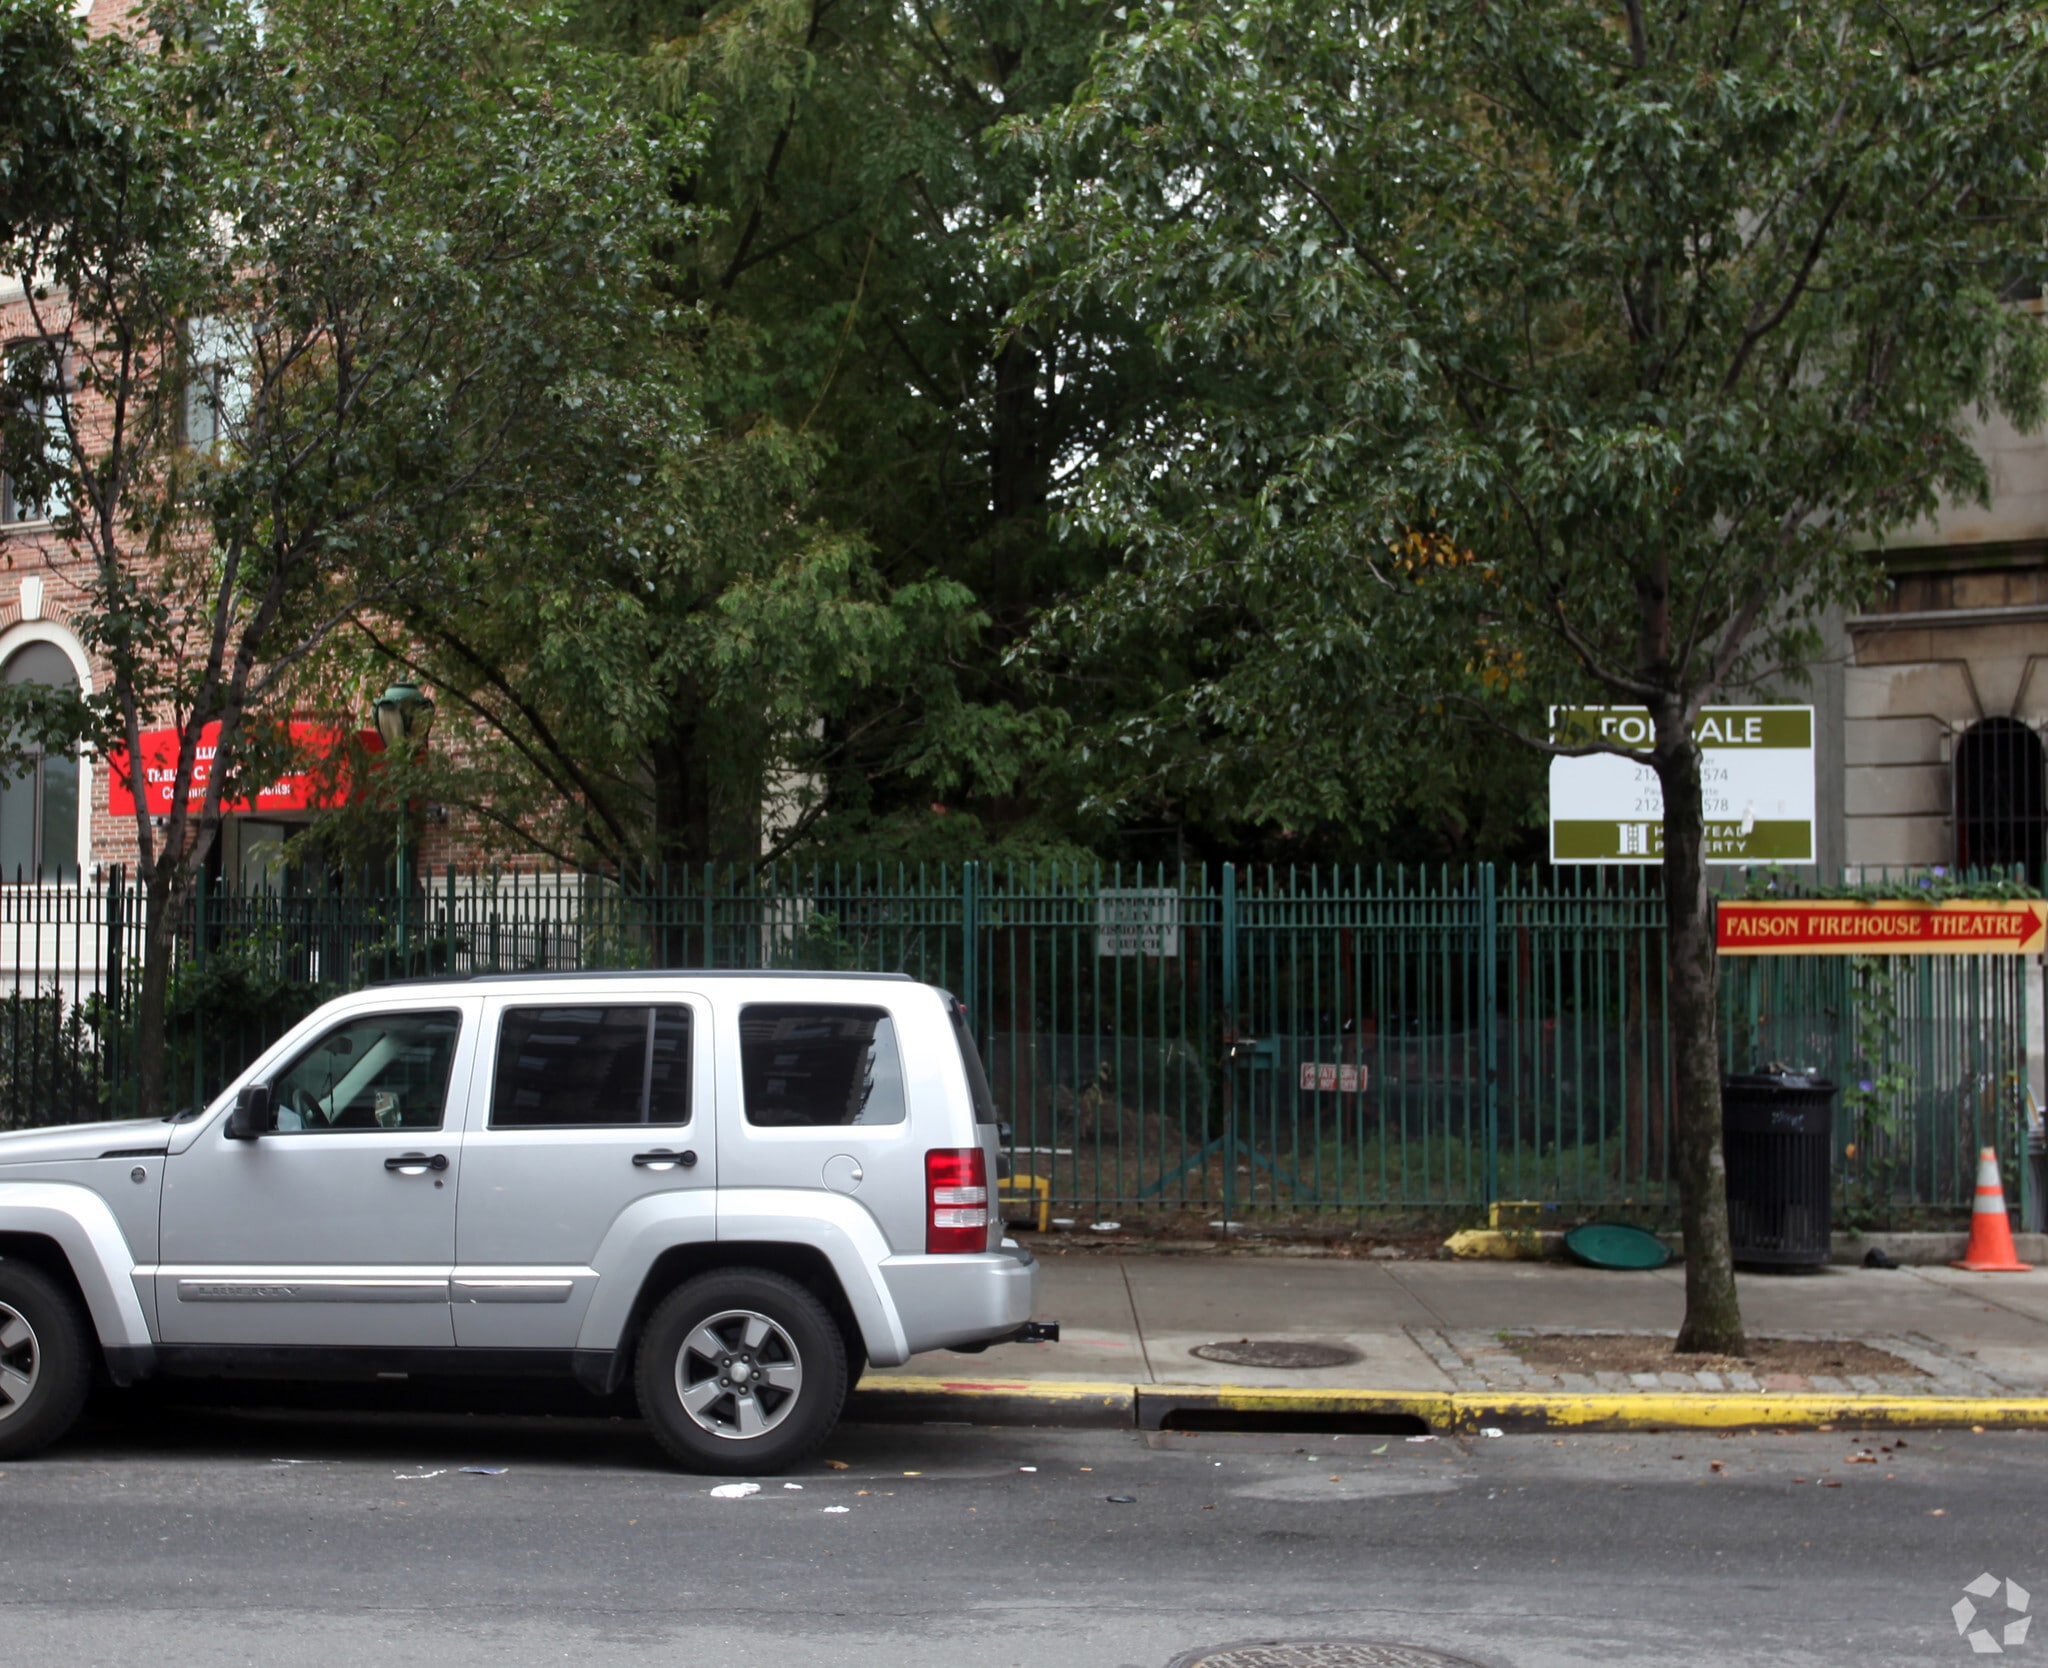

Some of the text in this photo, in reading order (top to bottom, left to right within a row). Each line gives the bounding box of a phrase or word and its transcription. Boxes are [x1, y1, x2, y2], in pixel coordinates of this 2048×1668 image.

[1691, 716, 1763, 743] ALE
[1726, 915, 2023, 936] FAISON FIREHOUSE THEATRE
